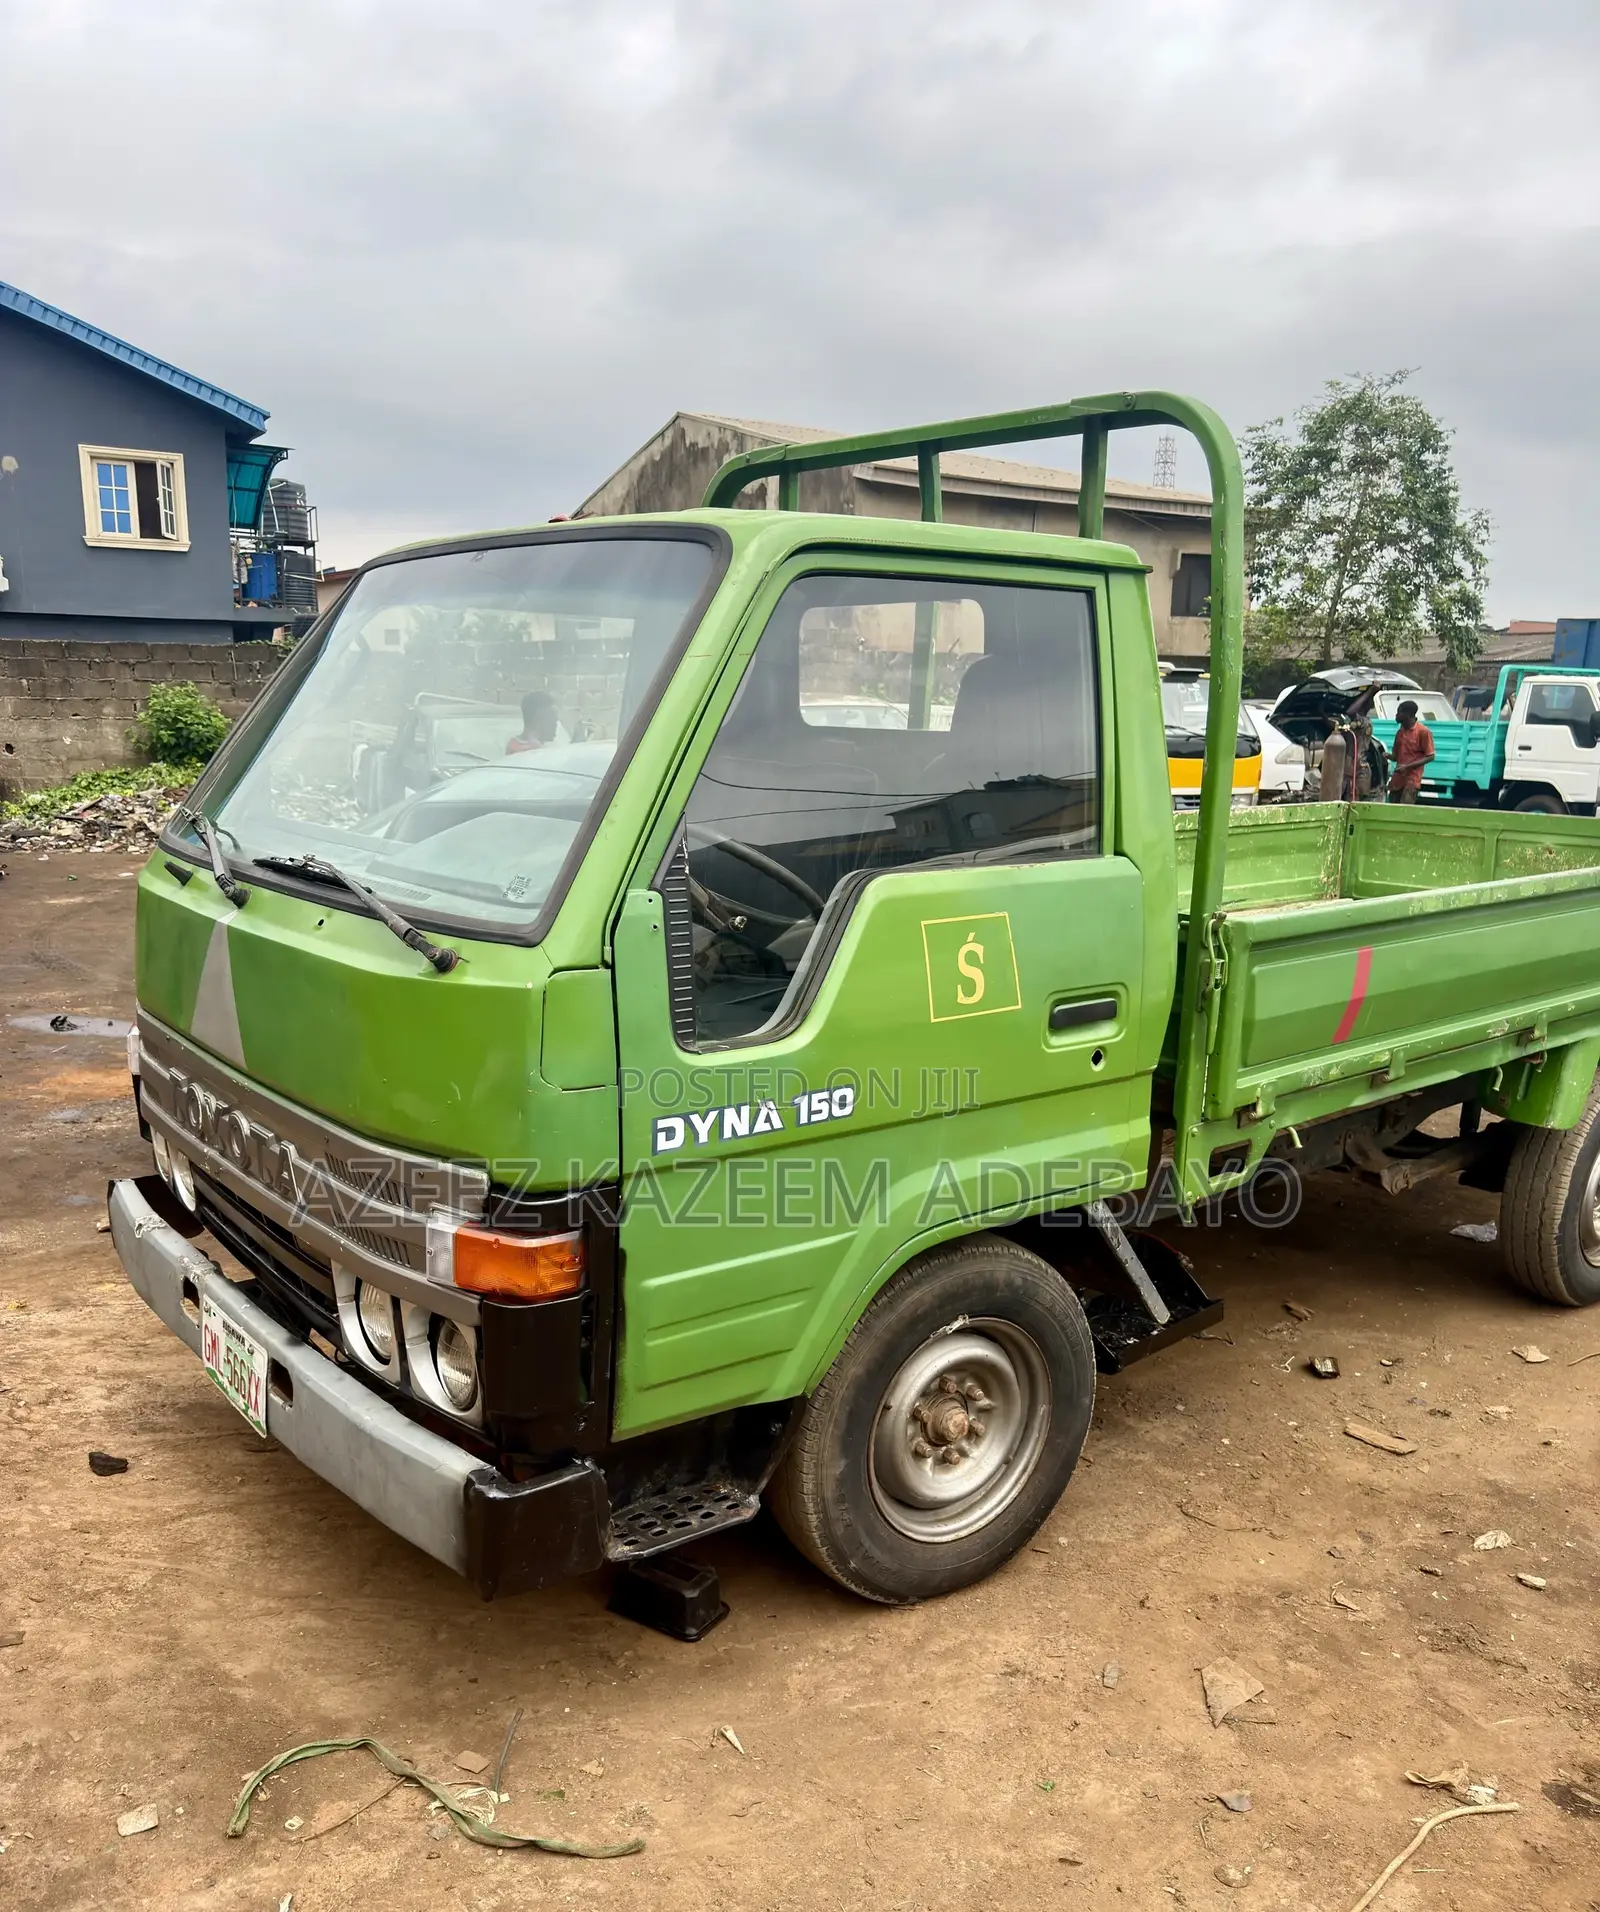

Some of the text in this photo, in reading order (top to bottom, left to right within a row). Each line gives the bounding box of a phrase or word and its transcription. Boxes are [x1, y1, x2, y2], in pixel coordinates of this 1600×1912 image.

[168, 1067, 304, 1208] TOYOTA
[654, 1085, 858, 1154] DYNA 150
